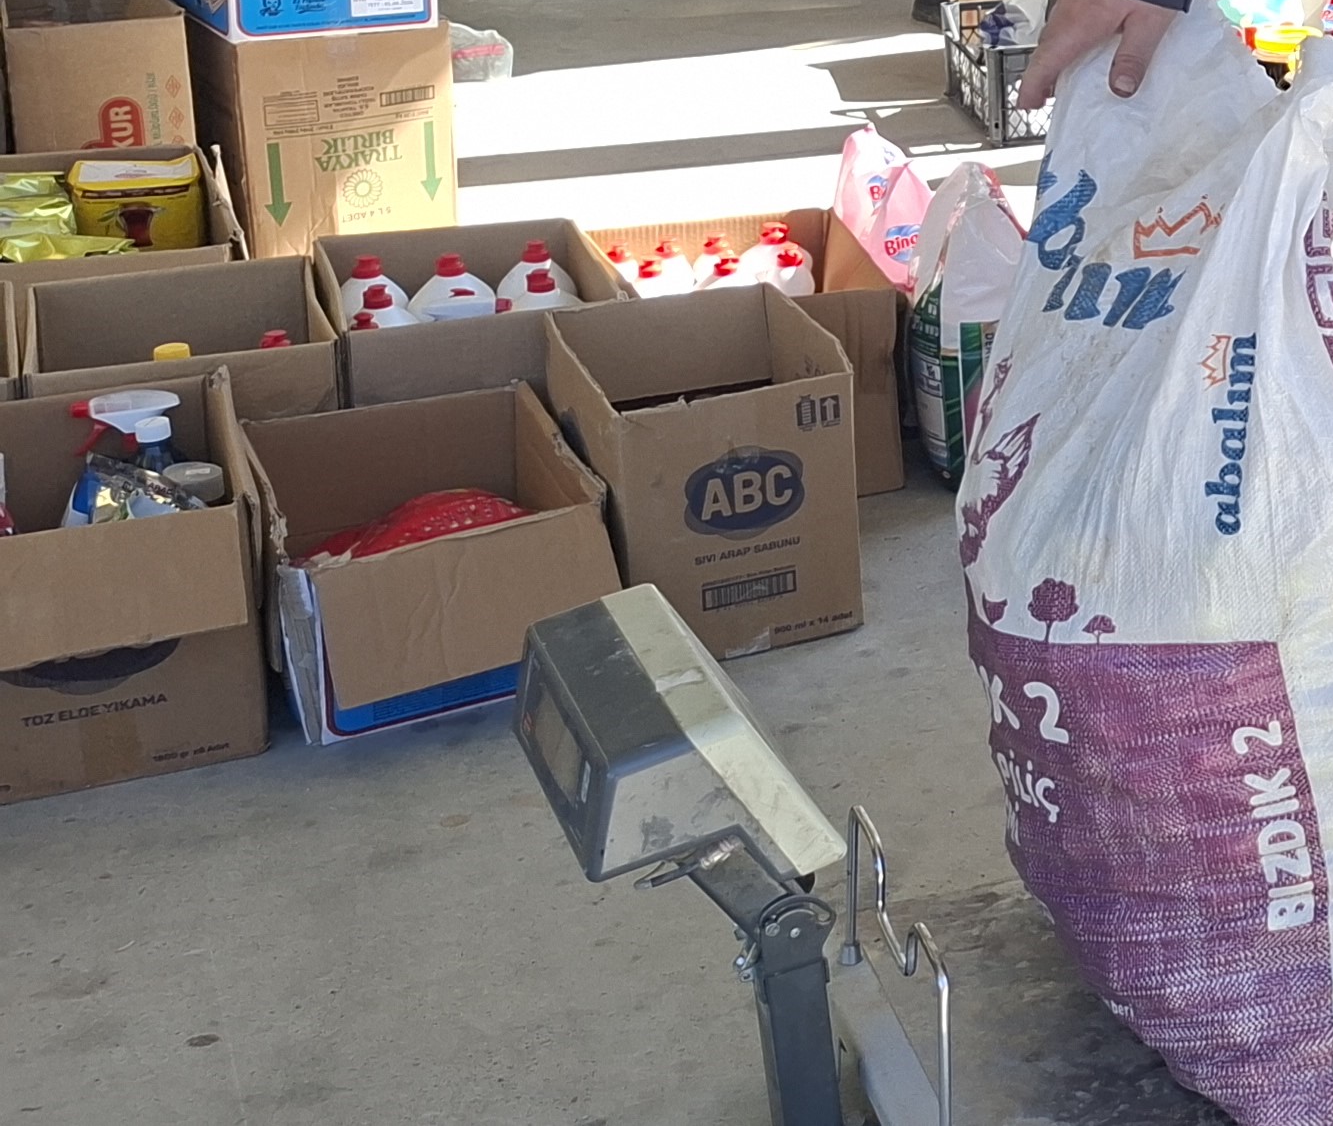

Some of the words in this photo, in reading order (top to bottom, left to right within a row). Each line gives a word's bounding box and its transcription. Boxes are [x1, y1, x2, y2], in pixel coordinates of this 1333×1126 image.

[109, 105, 135, 148] KUR
[314, 144, 403, 172] TRAKYA
[701, 464, 793, 521] ABC
[719, 546, 751, 562] ARAP
[753, 536, 801, 556] SABUNU
[21, 713, 55, 729] TOZ
[99, 692, 169, 714] YIKAMA
